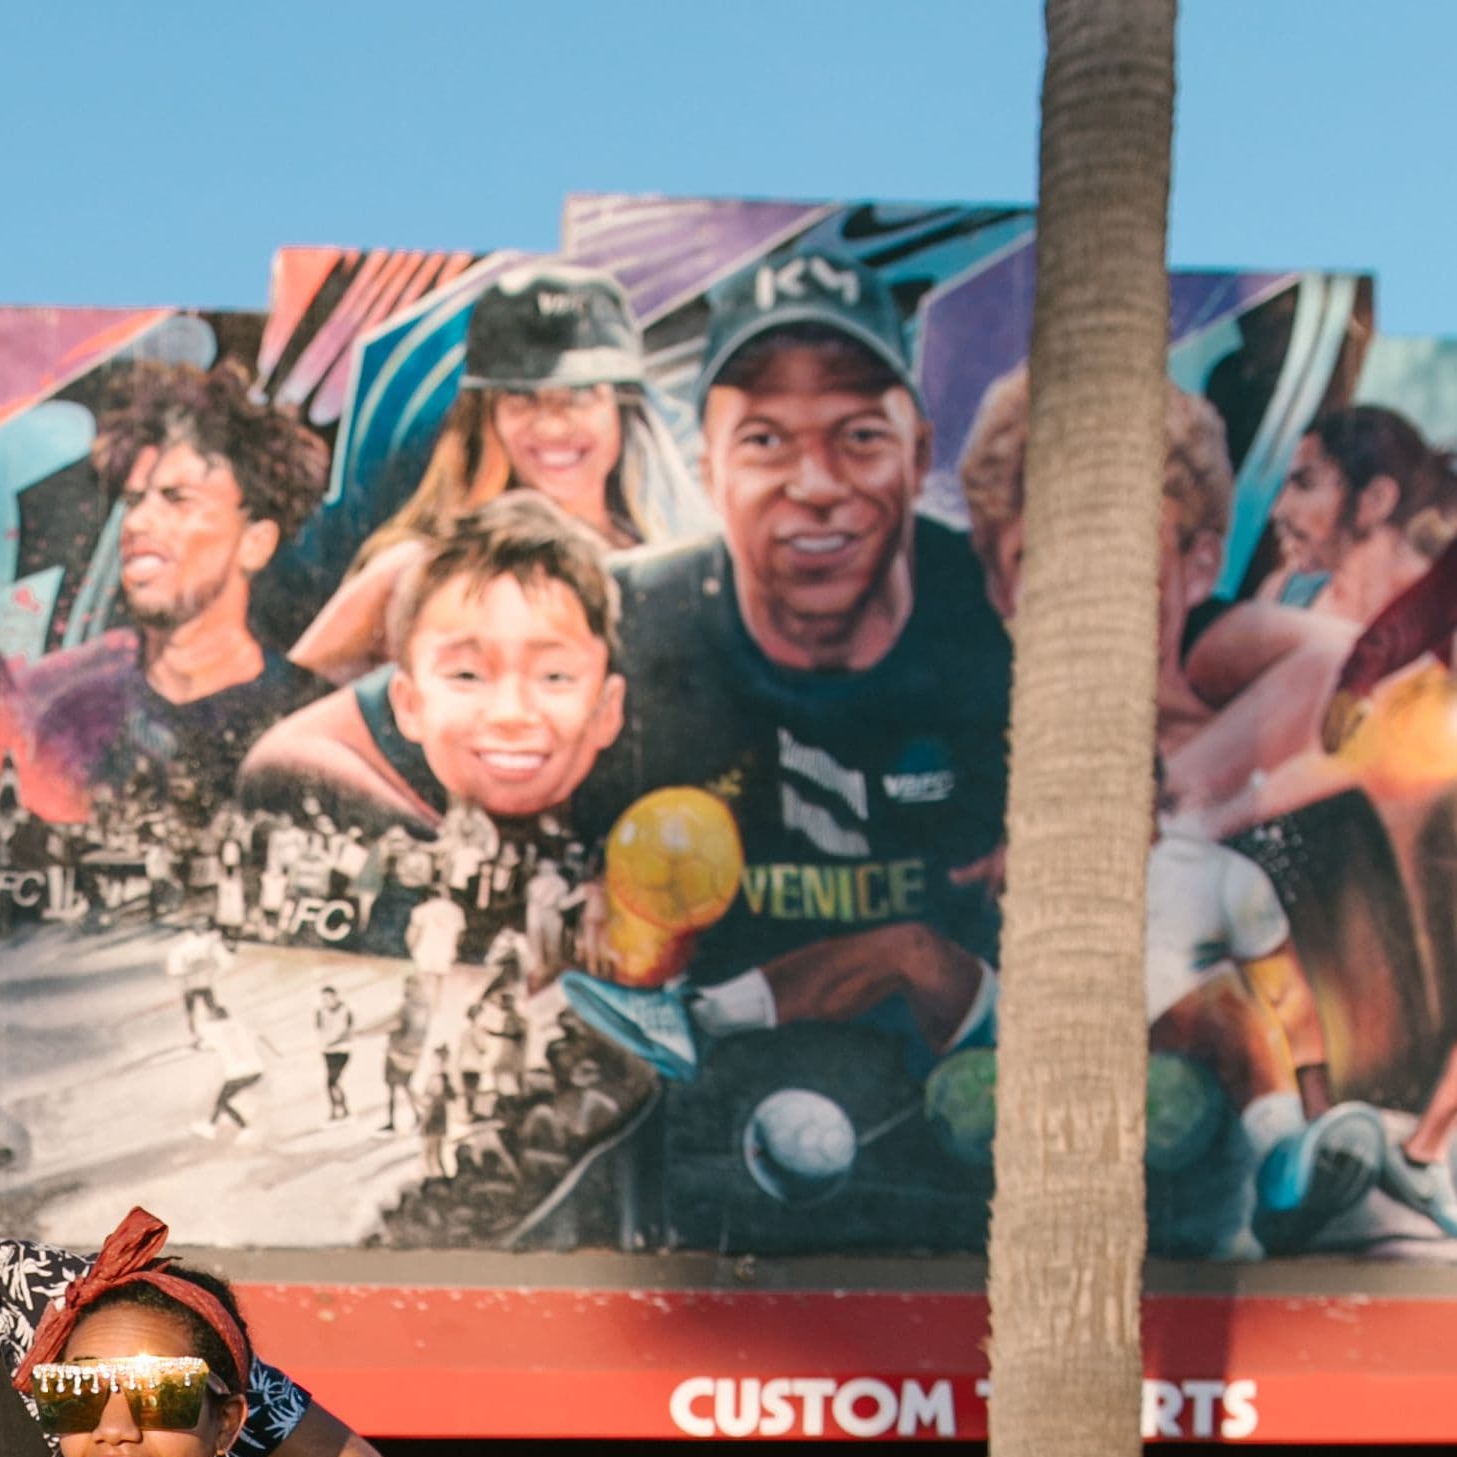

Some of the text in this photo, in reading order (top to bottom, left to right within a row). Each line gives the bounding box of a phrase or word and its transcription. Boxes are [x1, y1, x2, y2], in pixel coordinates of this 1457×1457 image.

[740, 857, 926, 923] VENICE
[669, 1377, 1258, 1438] CUSTOM RTS
